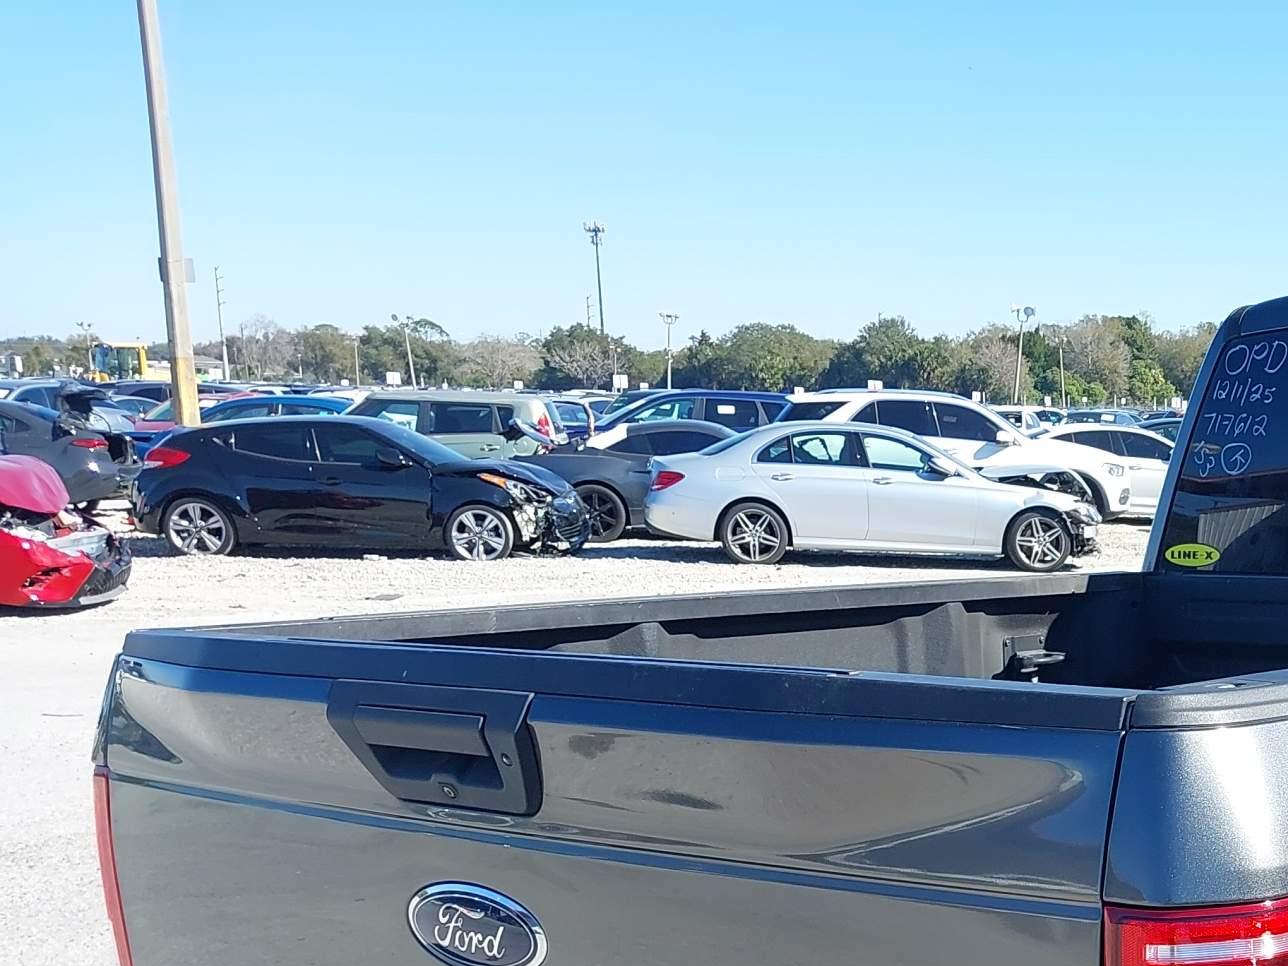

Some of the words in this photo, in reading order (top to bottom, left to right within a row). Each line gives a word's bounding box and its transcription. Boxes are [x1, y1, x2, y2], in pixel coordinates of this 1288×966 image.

[1224, 340, 1288, 376] OPD
[1203, 414, 1267, 438] 717612
[1170, 550, 1213, 560] LINE-X
[434, 903, 505, 958] Ford
